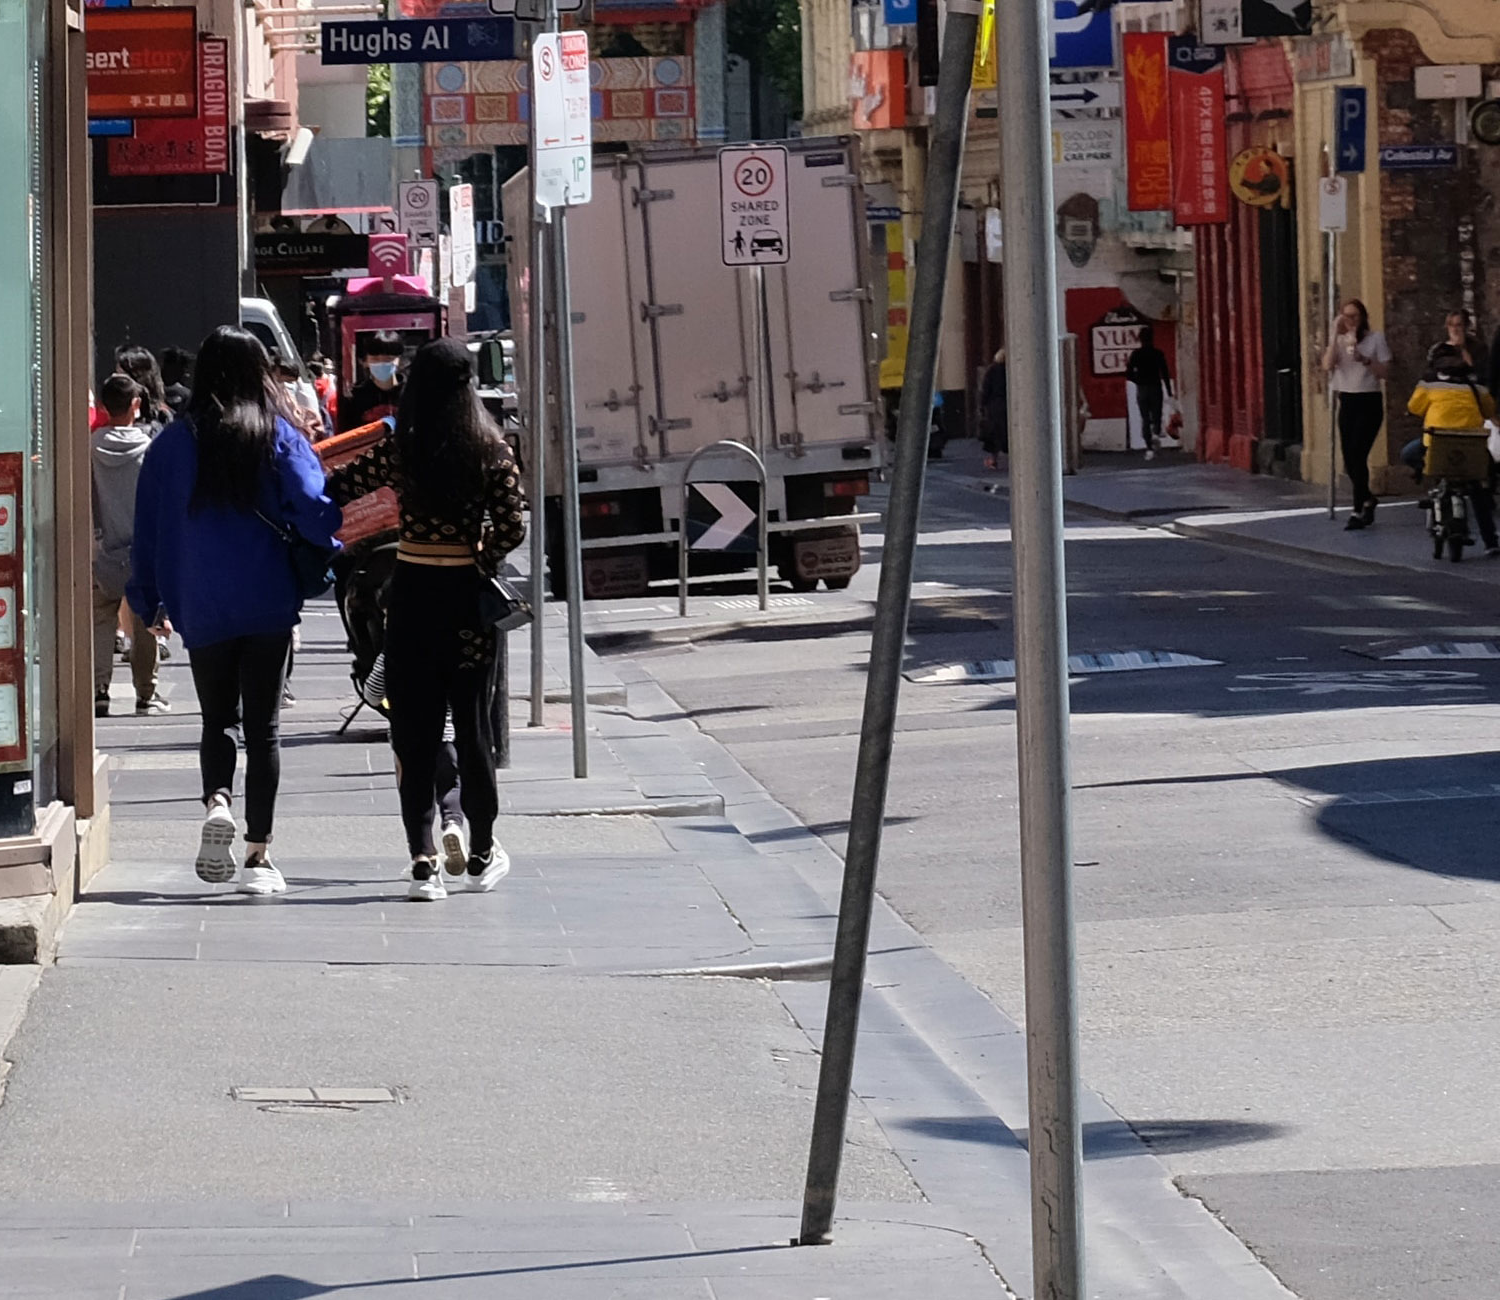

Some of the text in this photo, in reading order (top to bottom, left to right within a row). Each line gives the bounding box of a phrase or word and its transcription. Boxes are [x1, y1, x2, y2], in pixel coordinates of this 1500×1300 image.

[328, 26, 450, 53] Hughs Al
[202, 40, 228, 174] DRAGON BOAT
[1342, 97, 1361, 132] P
[1063, 130, 1113, 141] GOLDEN
[572, 156, 586, 182] 1P
[740, 167, 769, 186] 20
[410, 192, 427, 203] 20
[730, 199, 781, 213] SHARED
[739, 213, 772, 227] ZONE
